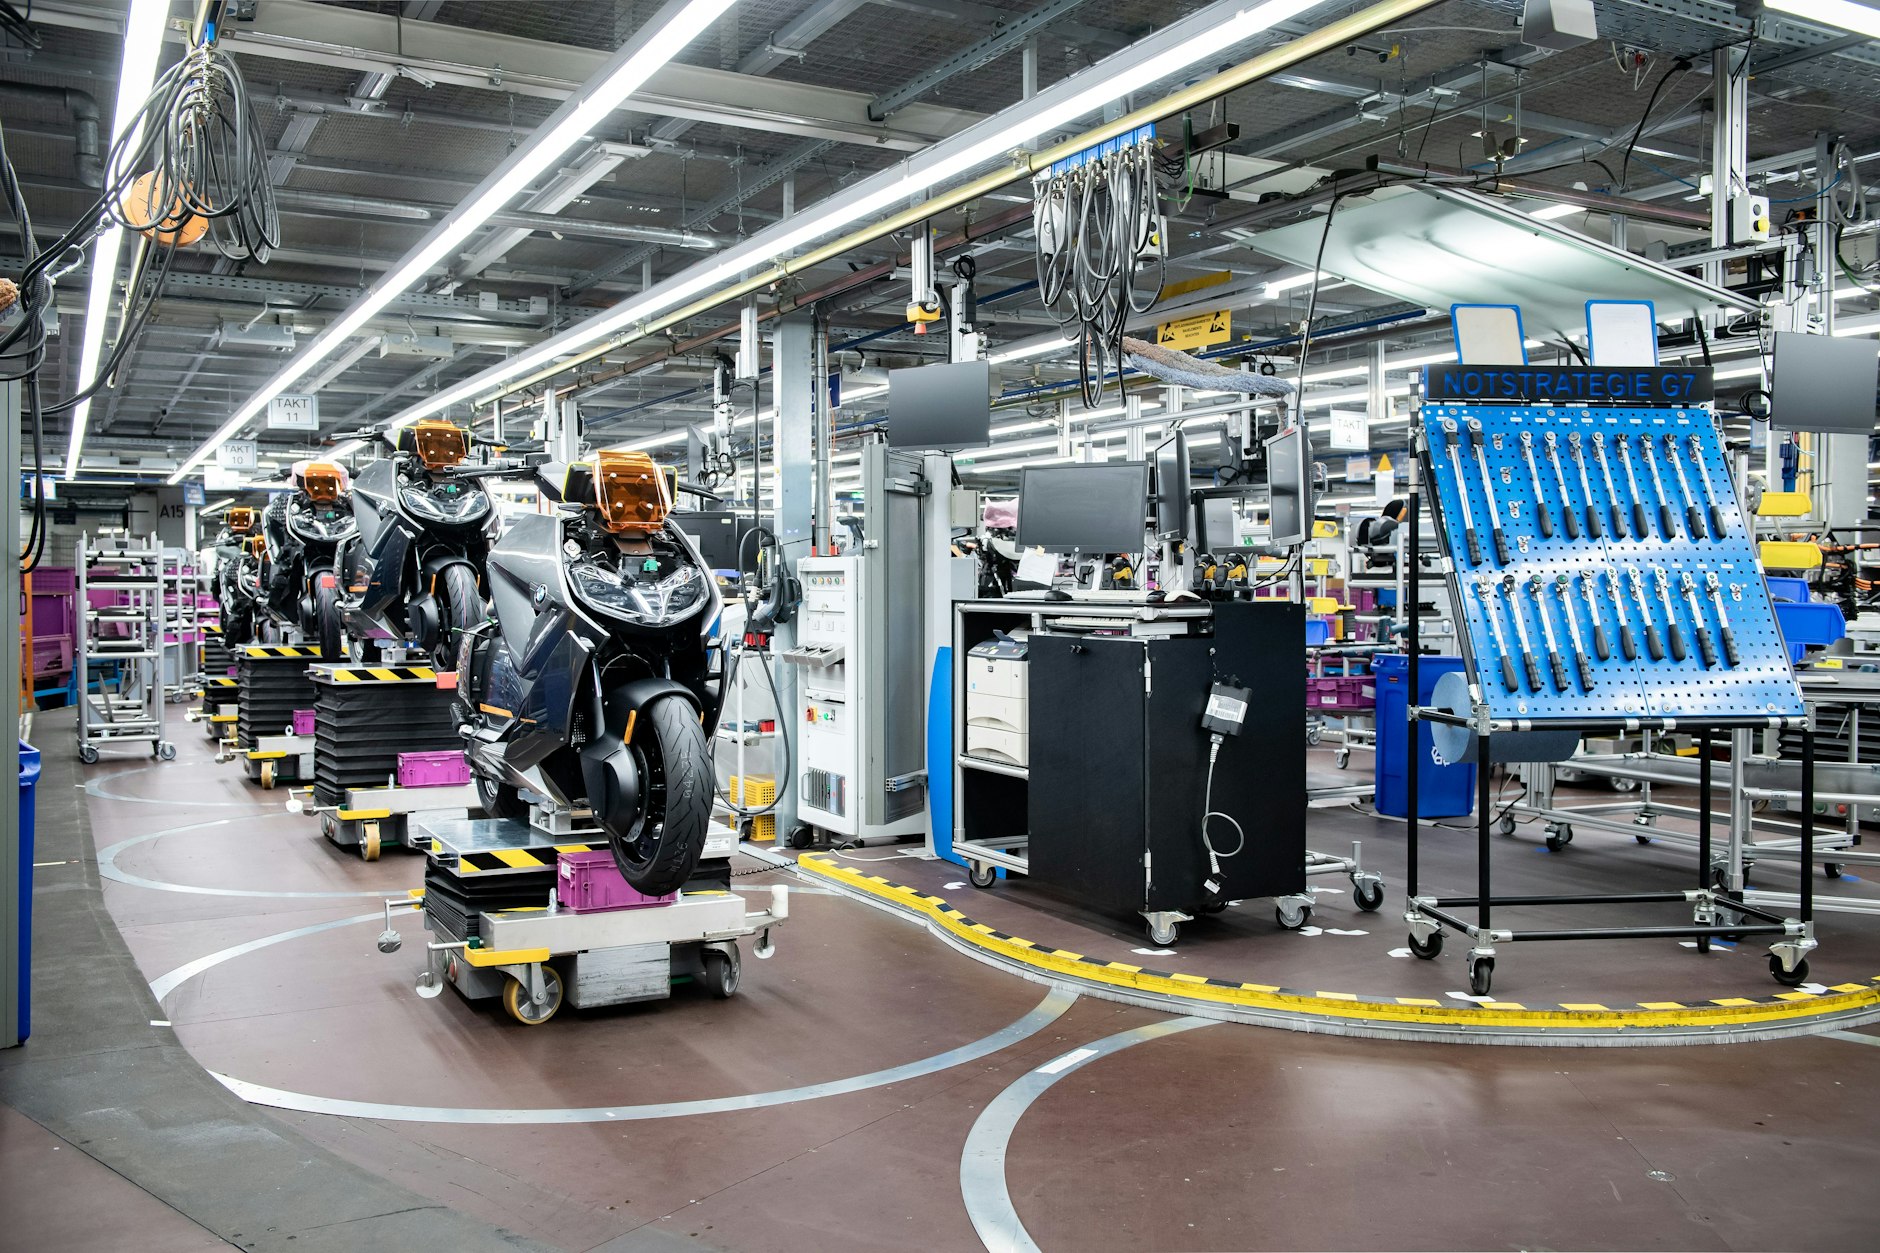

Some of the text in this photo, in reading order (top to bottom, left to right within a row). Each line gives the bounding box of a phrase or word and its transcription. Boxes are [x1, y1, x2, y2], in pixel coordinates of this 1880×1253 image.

[1444, 371, 1697, 397] NOTSTRATEGIE G7
[275, 398, 309, 408] TAKT
[286, 412, 298, 421] 11
[1337, 418, 1361, 430] TAKT
[224, 445, 250, 454] TAKT
[233, 456, 244, 464] 10
[160, 504, 184, 518] A15
